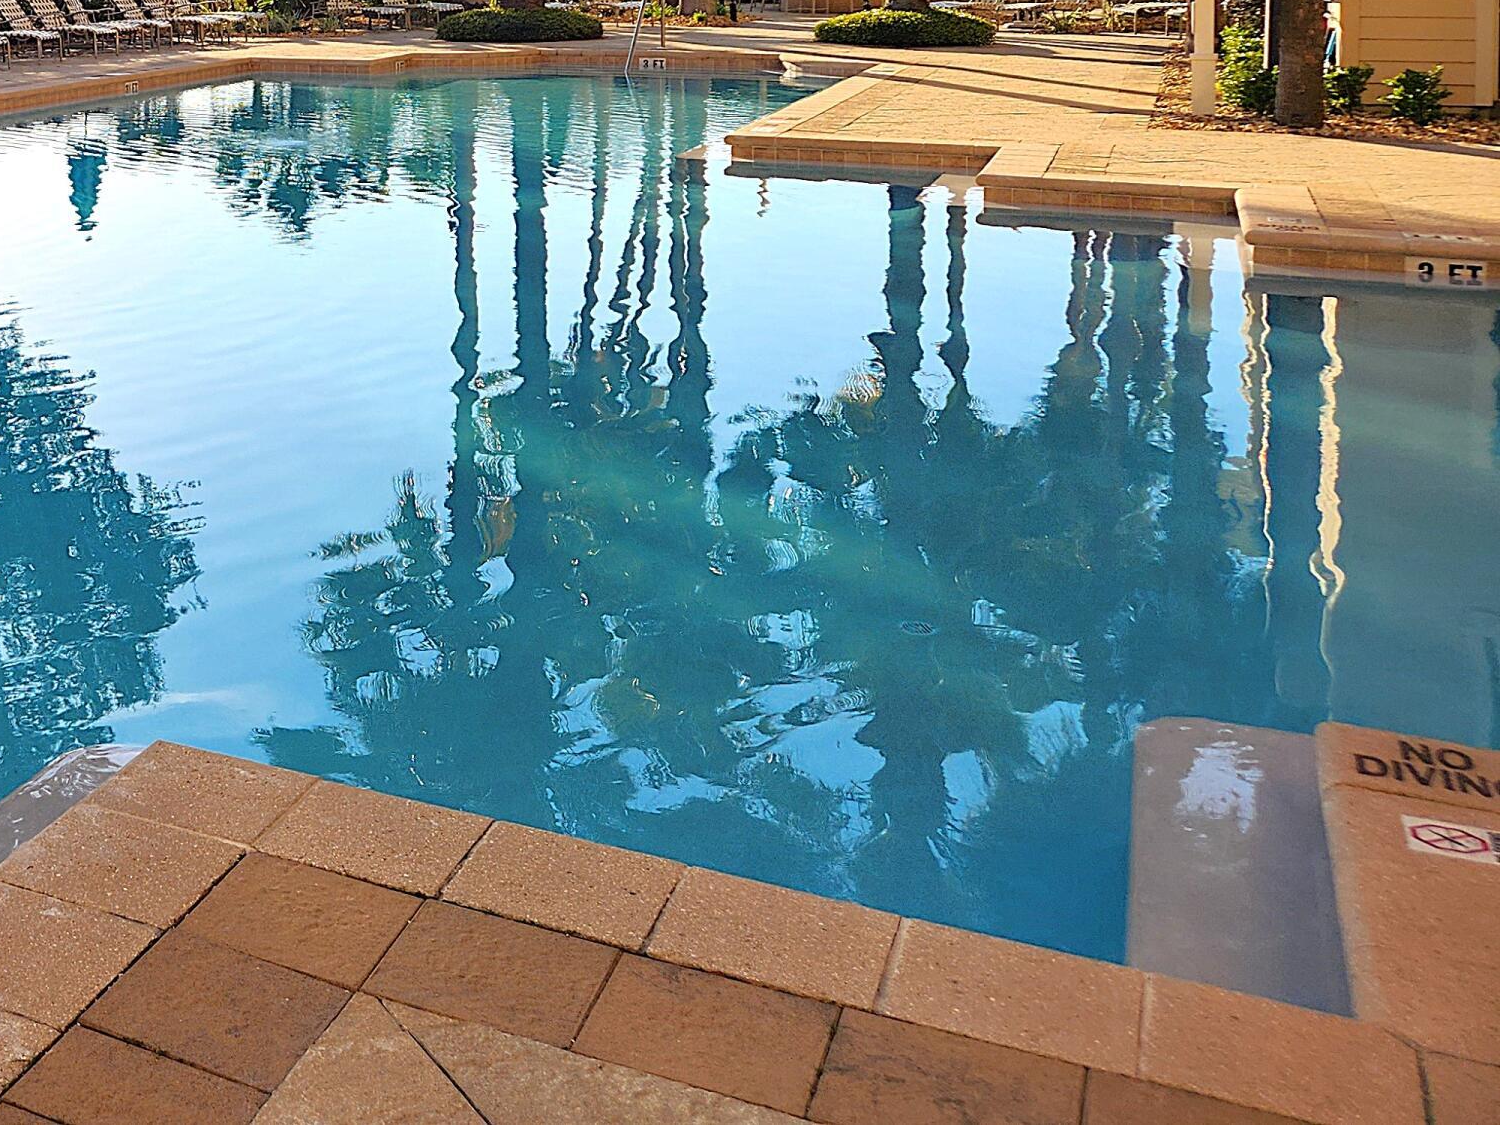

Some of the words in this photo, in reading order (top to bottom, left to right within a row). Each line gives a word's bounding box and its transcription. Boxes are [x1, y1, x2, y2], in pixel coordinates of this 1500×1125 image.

[653, 59, 665, 69] FT
[1448, 263, 1483, 279] FT
[1398, 740, 1476, 771] NO
[1353, 753, 1500, 798] DIVIN
